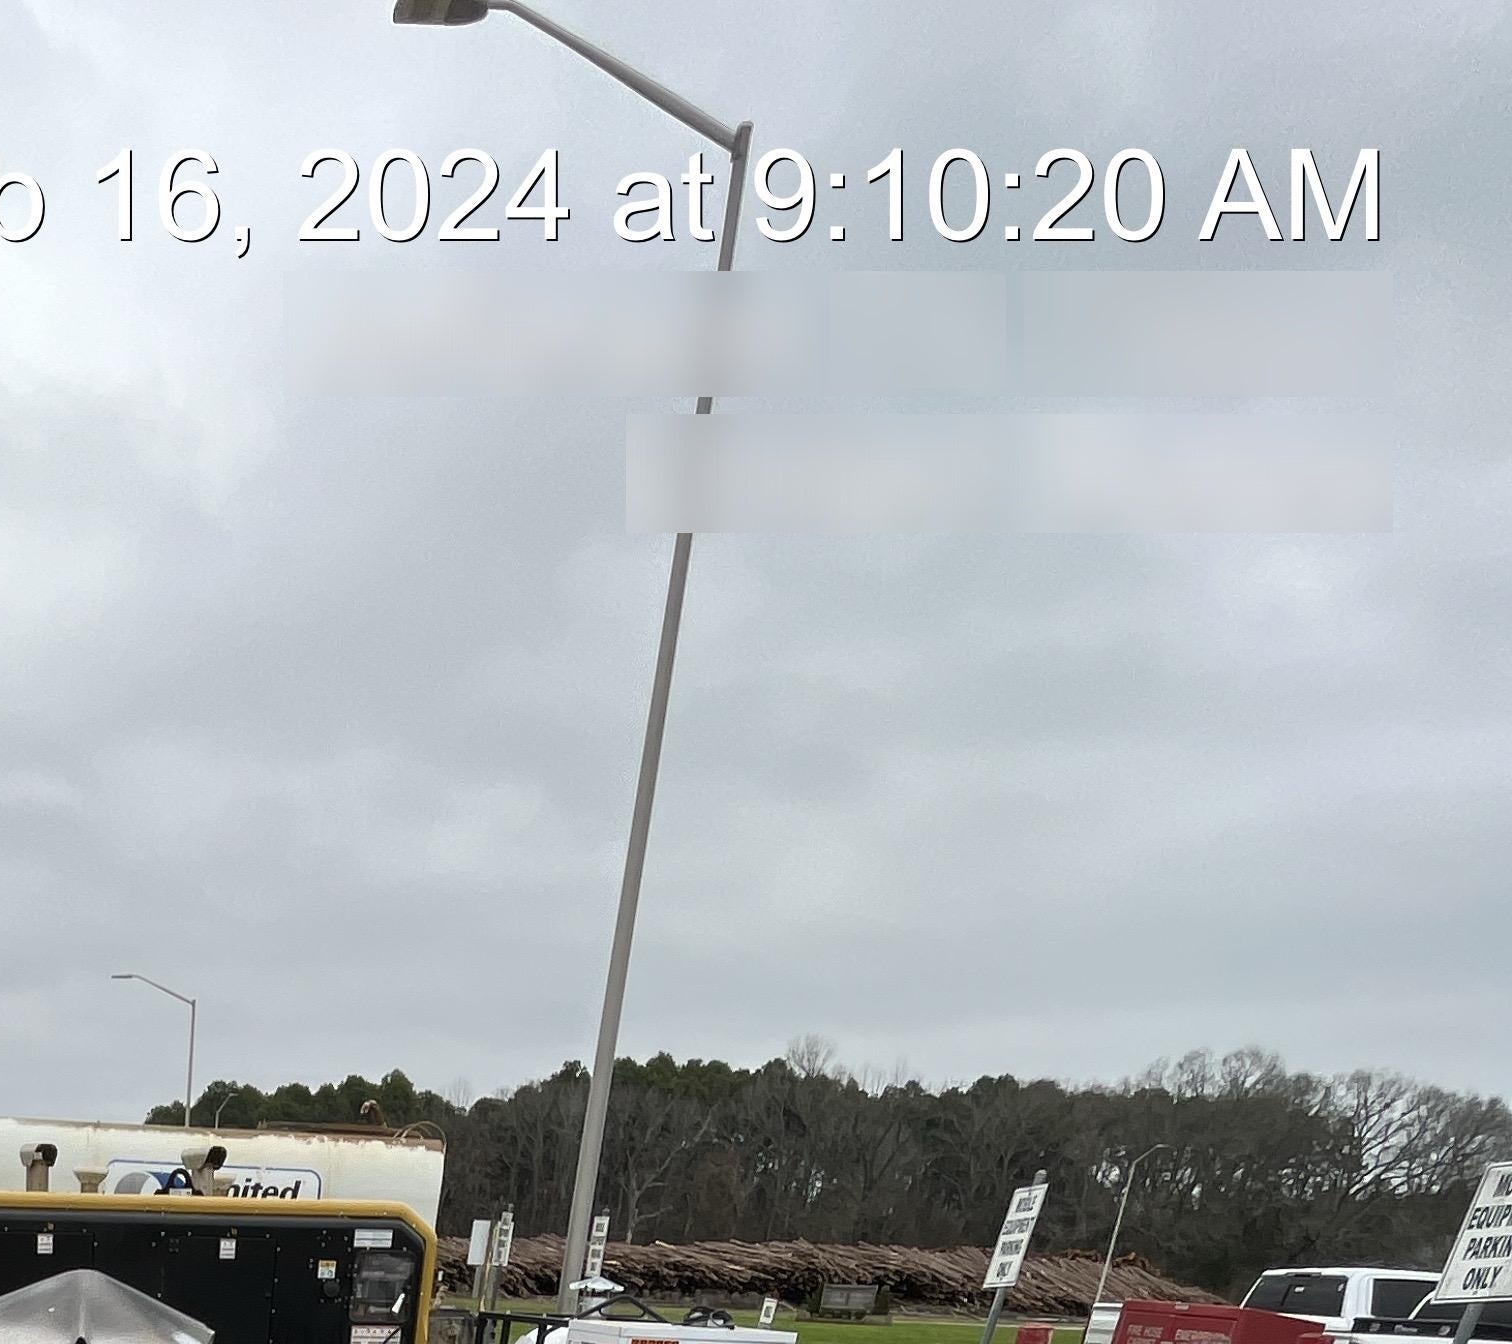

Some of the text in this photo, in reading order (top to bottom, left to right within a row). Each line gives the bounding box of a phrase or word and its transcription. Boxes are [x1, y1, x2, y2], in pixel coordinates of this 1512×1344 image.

[227, 1178, 301, 1199] nited
[1467, 1204, 1512, 1231] EQUIP
[1462, 1235, 1512, 1261] PARKIN
[1462, 1266, 1503, 1291] ONLY
